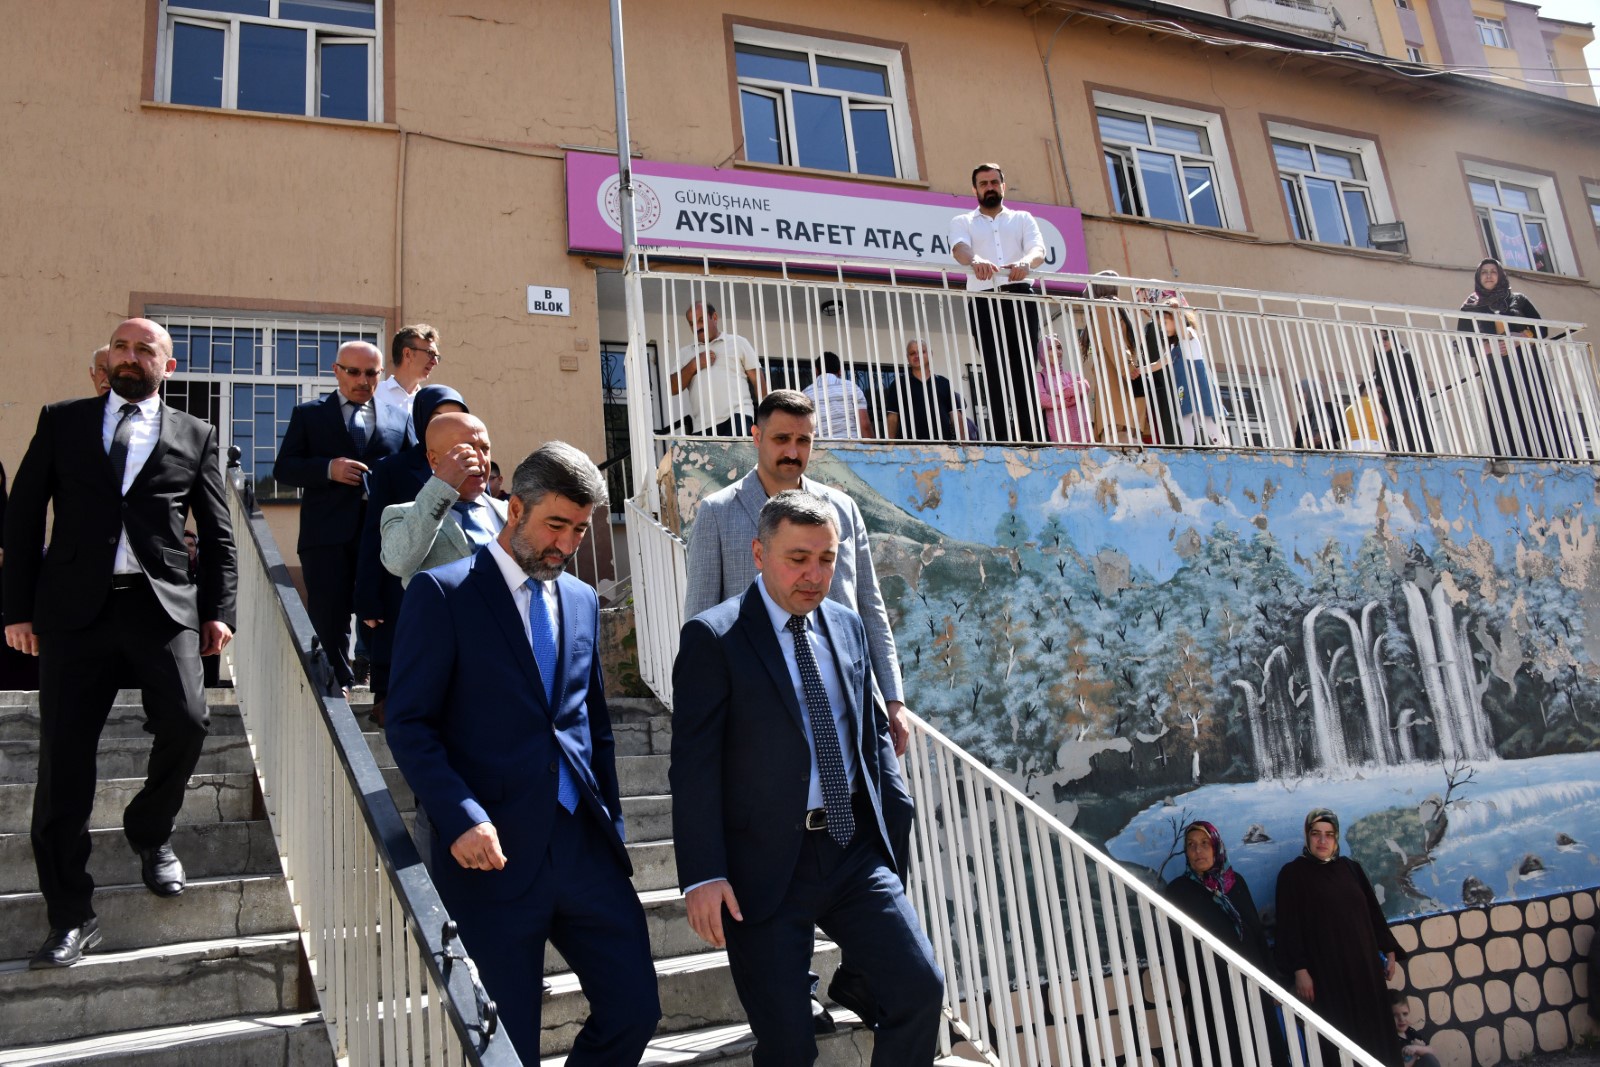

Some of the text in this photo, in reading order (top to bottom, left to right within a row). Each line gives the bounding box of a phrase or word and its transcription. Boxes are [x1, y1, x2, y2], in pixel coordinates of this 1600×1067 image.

[674, 189, 772, 212] GÜMÜŞHANE
[675, 209, 754, 237] AYSIN
[775, 218, 856, 246] RAFET
[863, 226, 924, 258] ATAÇ
[544, 289, 553, 300] B
[534, 300, 564, 313] BLOK
